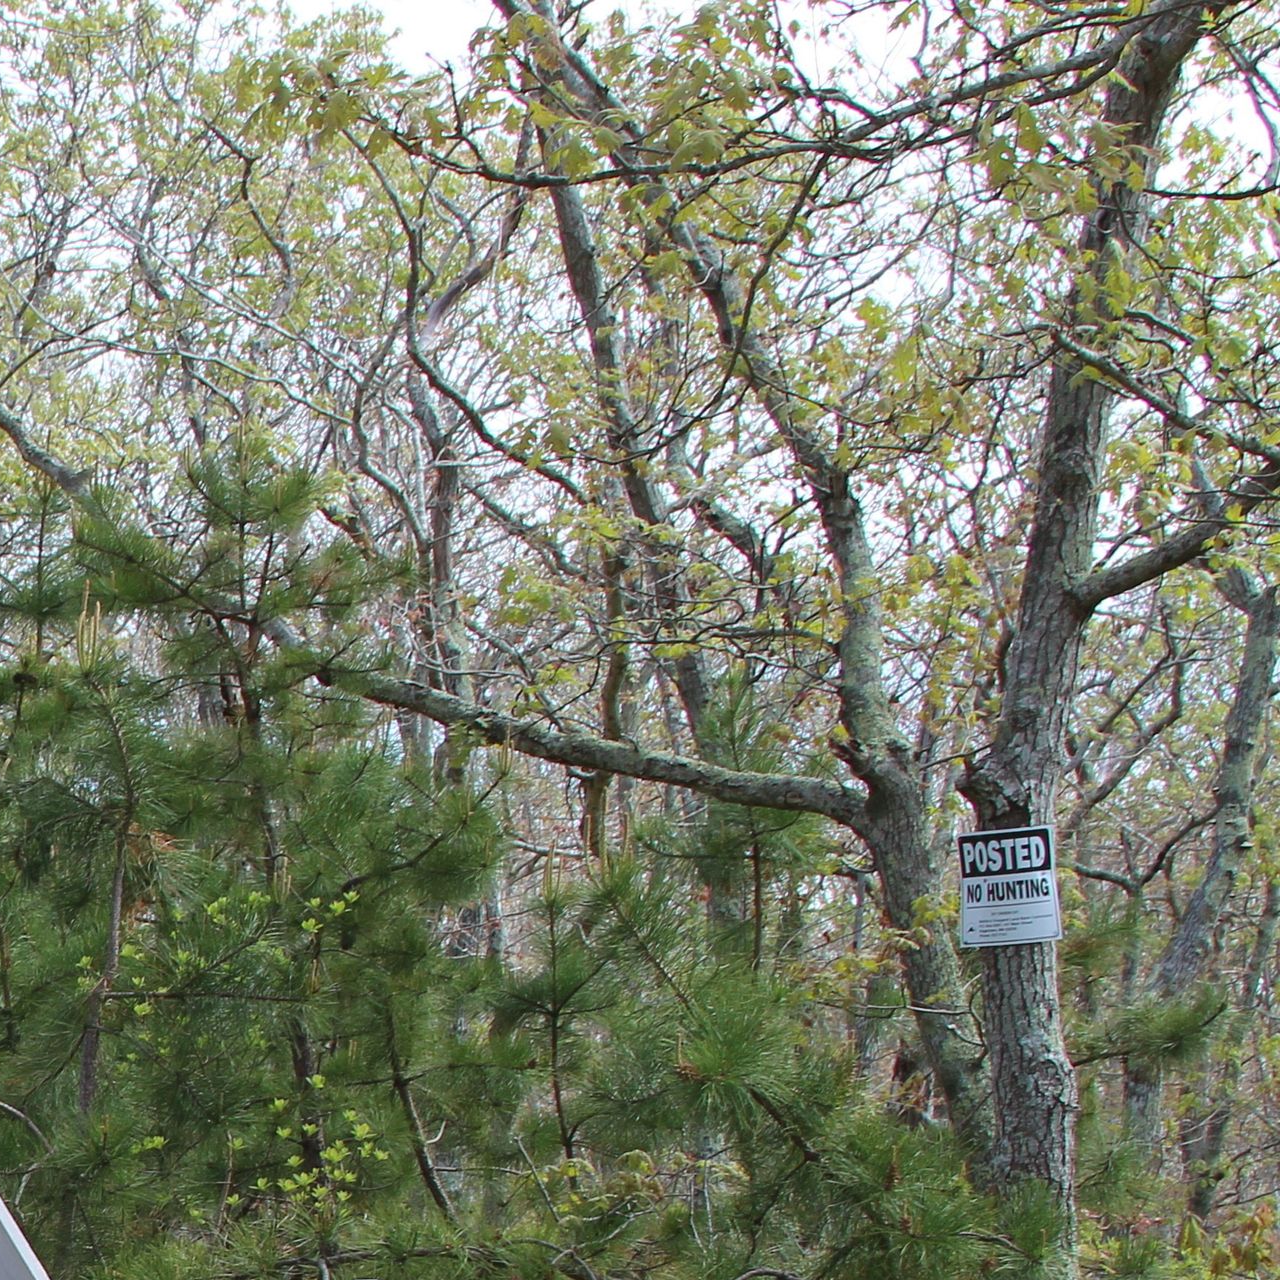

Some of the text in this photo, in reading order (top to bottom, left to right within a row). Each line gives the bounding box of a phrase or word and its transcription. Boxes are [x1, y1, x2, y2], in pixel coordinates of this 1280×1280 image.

[962, 836, 1046, 874] POSTED
[966, 878, 1049, 904] NO HUNTING
